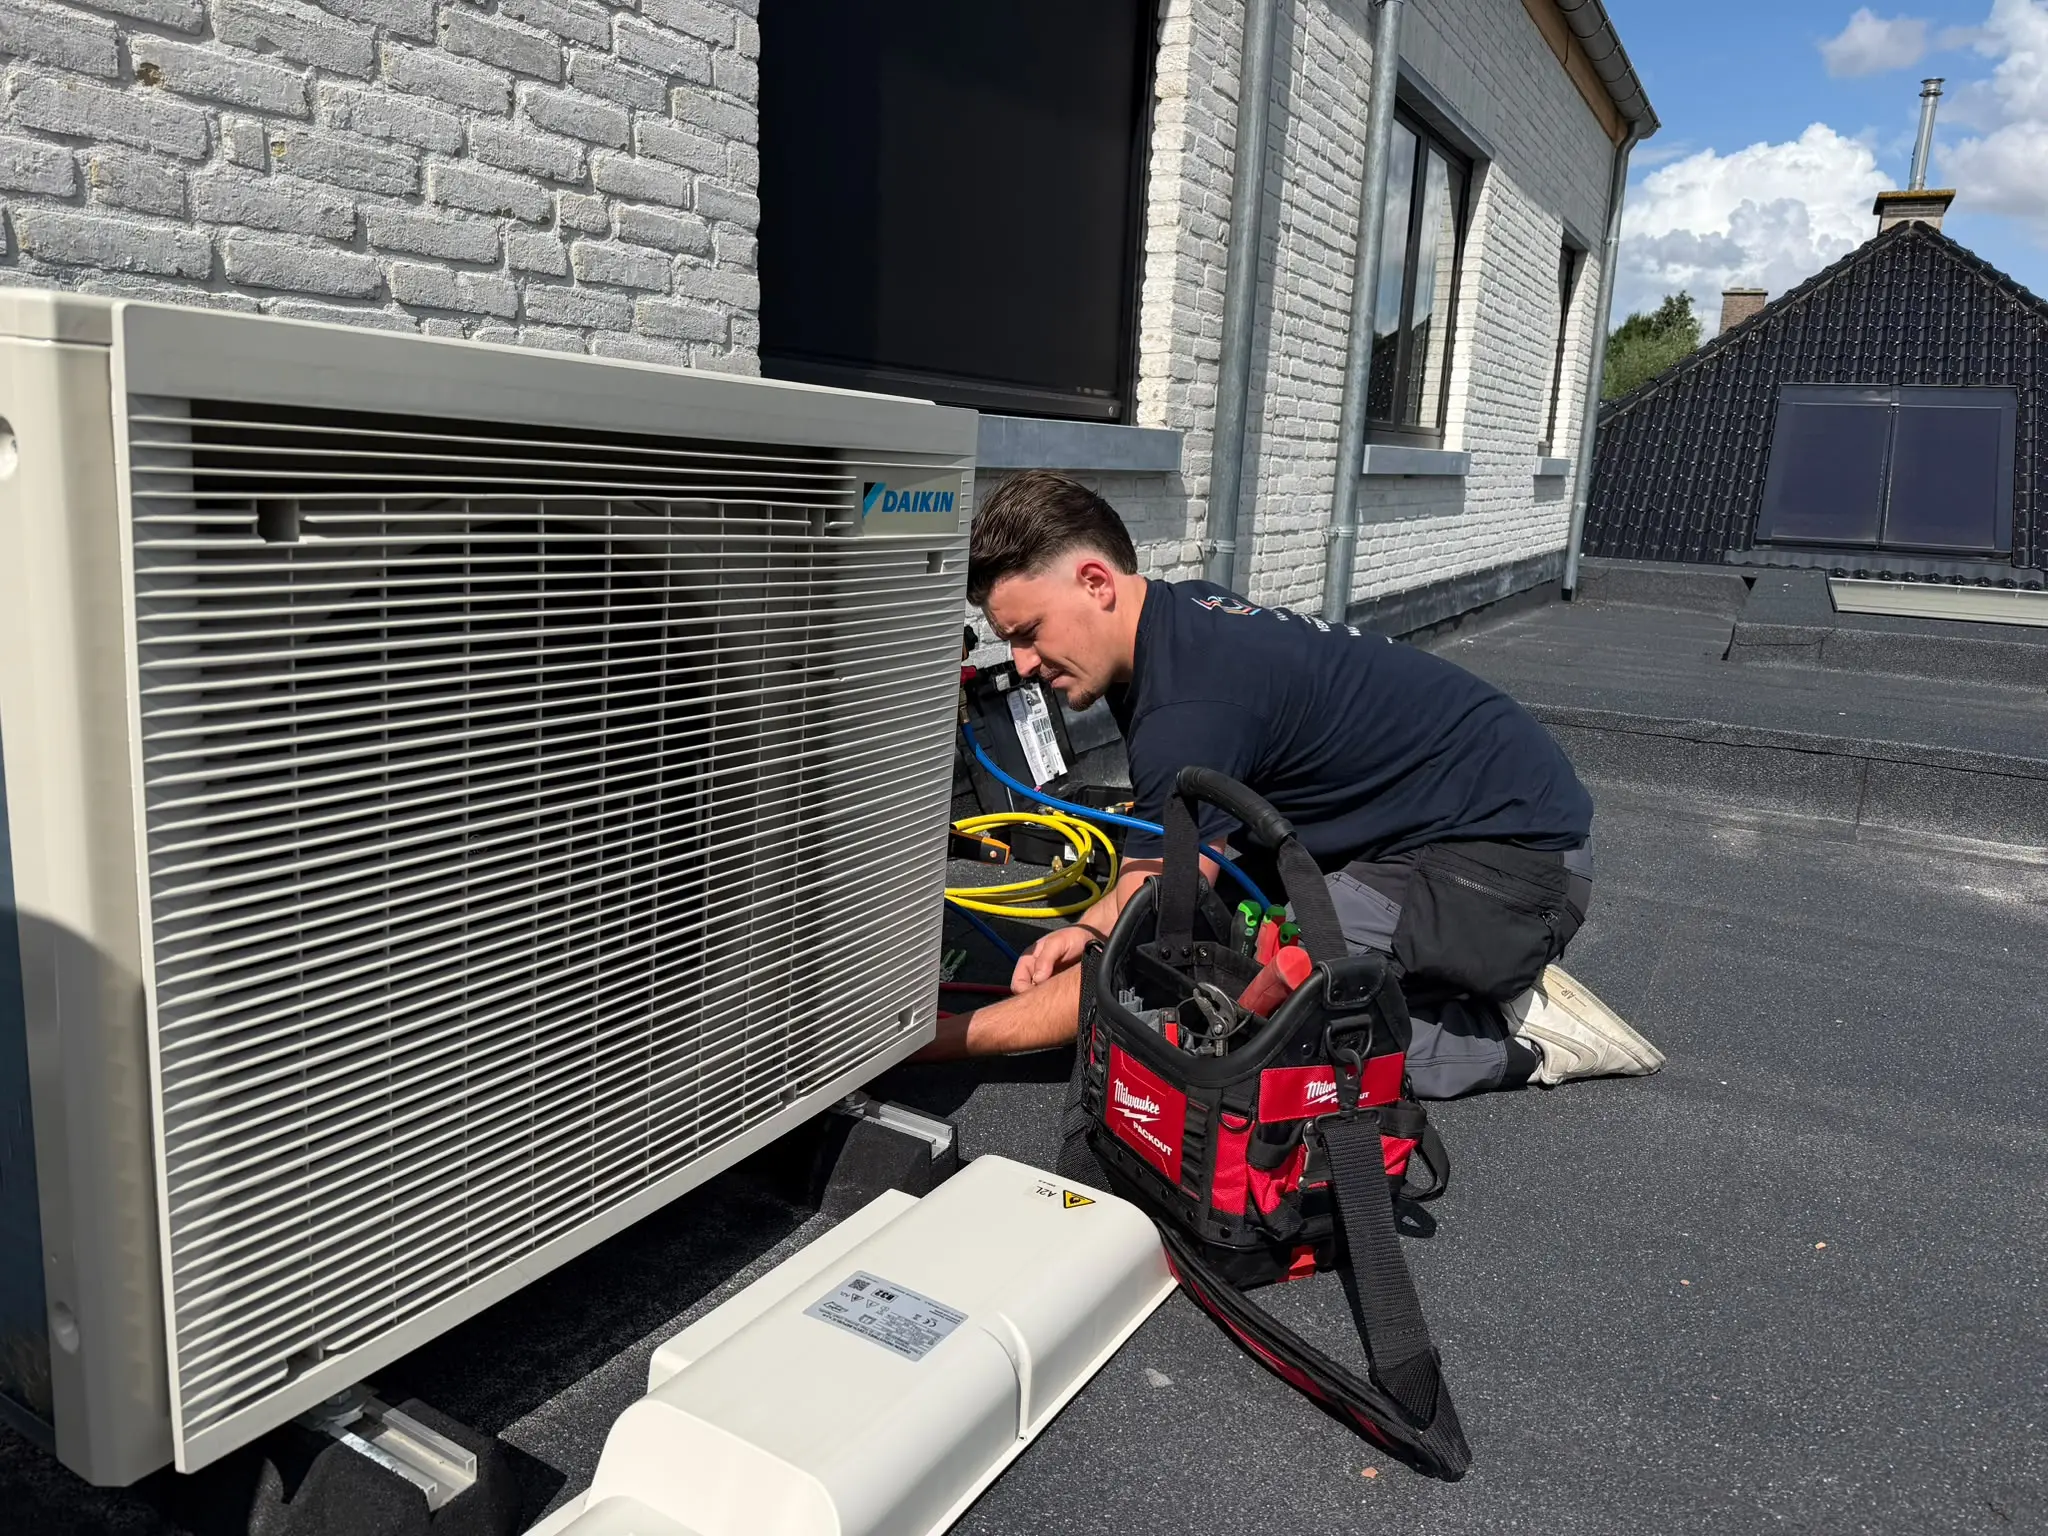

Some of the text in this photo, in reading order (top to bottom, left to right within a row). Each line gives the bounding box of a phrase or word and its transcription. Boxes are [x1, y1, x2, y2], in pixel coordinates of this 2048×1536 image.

[882, 490, 954, 512] DAIKIN
[1113, 1078, 1160, 1115] Milwaukee
[1133, 1120, 1172, 1156] PACKOUT
[1036, 1186, 1057, 1197] A2L
